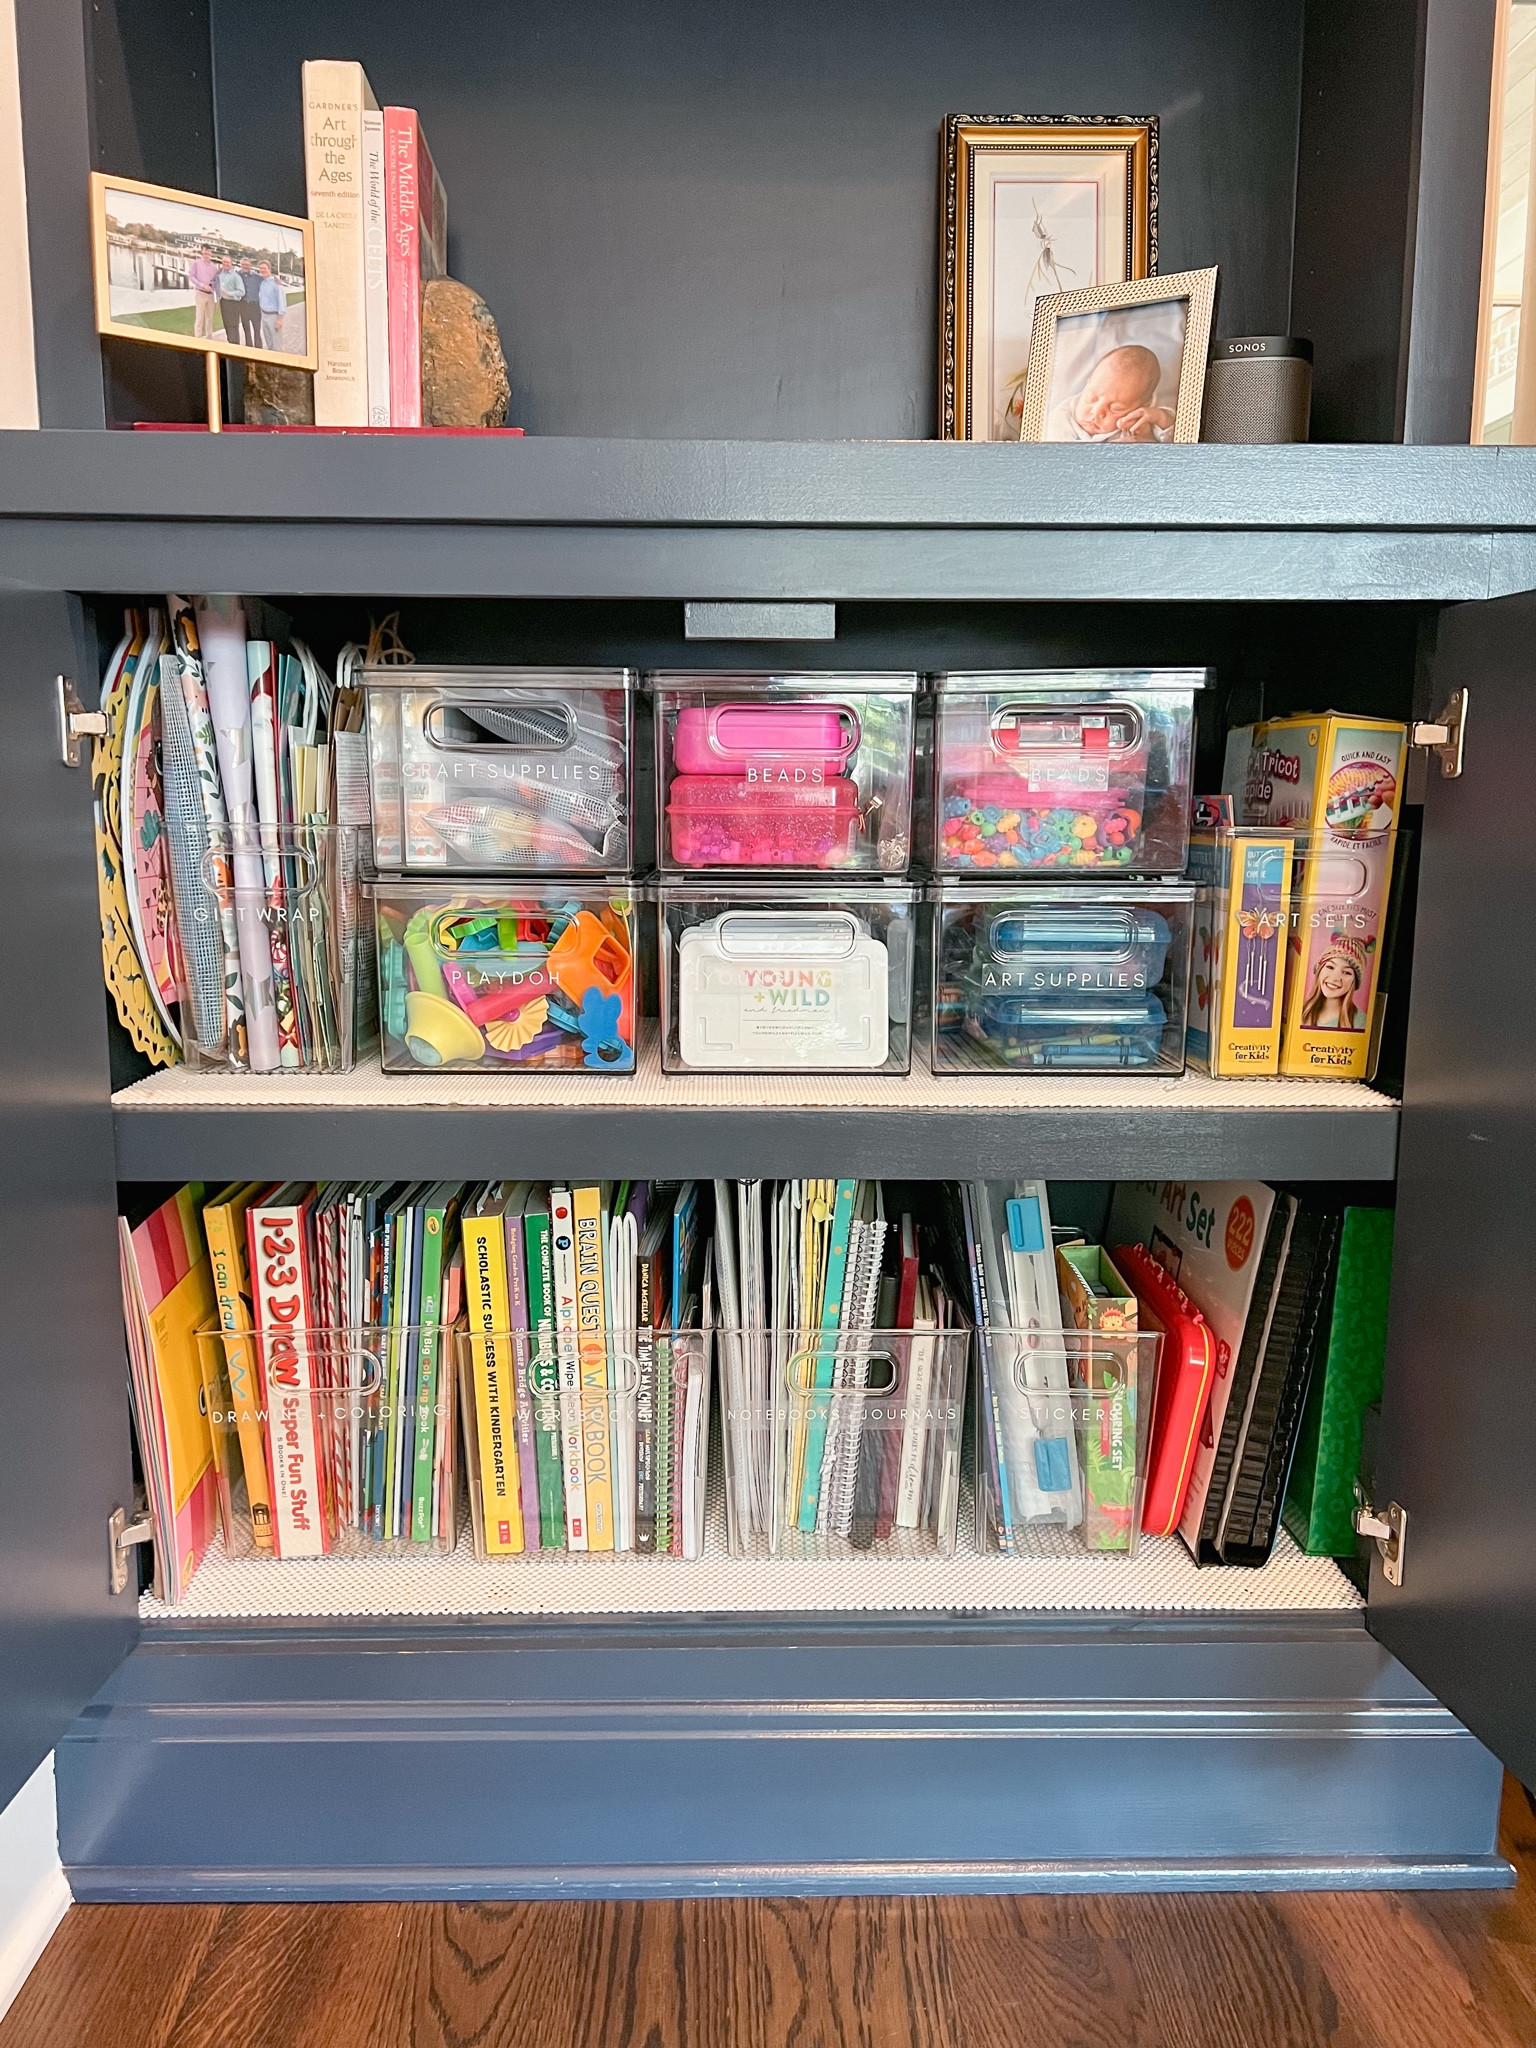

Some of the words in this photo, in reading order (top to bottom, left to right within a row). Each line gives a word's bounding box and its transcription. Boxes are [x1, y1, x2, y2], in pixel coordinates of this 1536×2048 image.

[308, 101, 359, 111] GARDNER'S
[322, 116, 346, 130] Art
[398, 126, 412, 158] The
[325, 150, 346, 164] the
[369, 152, 378, 170] The
[318, 168, 352, 184] Ages
[370, 171, 380, 198] World
[310, 190, 336, 198] seventh
[337, 190, 359, 198] edition
[399, 162, 414, 218] Middle
[368, 199, 380, 211] of
[370, 209, 380, 224] the
[396, 220, 414, 257] Ages
[366, 226, 385, 290] CELTS
[1228, 342, 1266, 354] SONOS
[1262, 751, 1300, 779] Tricot
[1341, 750, 1360, 762] QUICK
[1362, 750, 1376, 759] AND
[1375, 752, 1392, 765] EASY
[402, 763, 477, 779] CRAFT
[486, 764, 601, 780] SUPPLIES
[747, 767, 824, 783] BEADS
[1030, 768, 1107, 783] BEADS
[1352, 840, 1360, 850] ET
[193, 907, 247, 922] GIFT
[256, 907, 319, 922] WRAP
[1259, 913, 1300, 928] ART
[1310, 914, 1366, 928] SETS
[1318, 906, 1332, 916] ONE
[1360, 906, 1377, 919] MOST
[452, 970, 560, 986] PLAYDOH
[744, 970, 832, 988] YOUNG
[984, 972, 1026, 986] ART
[1034, 972, 1145, 987] SUPPLIES
[768, 988, 831, 1006] WILD
[1228, 1042, 1271, 1052] Creativity
[1235, 1052, 1248, 1060] for
[1248, 1050, 1270, 1060] Kids
[1302, 1042, 1356, 1056] Creativity
[1310, 1054, 1326, 1064] for
[1327, 1054, 1353, 1066] Kids
[1186, 1190, 1216, 1249] Set
[1228, 1206, 1253, 1246] 222
[510, 1227, 518, 1254] Bridging
[540, 1230, 548, 1244] THE
[578, 1218, 598, 1275] BRAIN
[383, 1265, 388, 1273] TO
[541, 1245, 550, 1282] COMPLETE
[216, 1262, 228, 1290] can
[476, 1236, 492, 1311] SCHOLASTIC
[542, 1283, 550, 1304] BOOK
[219, 1294, 236, 1332] draw
[543, 1306, 550, 1317] OF
[579, 1280, 602, 1339] QUEST
[268, 1294, 301, 1386] Draw
[421, 1338, 432, 1354] Big
[483, 1316, 496, 1368] SUCCESS
[516, 1327, 526, 1367] Summer
[638, 1344, 652, 1372] TIMES
[420, 1358, 431, 1402] Coloring
[540, 1367, 552, 1376] &
[487, 1370, 499, 1404] WITH
[518, 1369, 527, 1398] Bridge
[280, 1397, 300, 1449] Super
[317, 1412, 326, 1420] +
[419, 1405, 430, 1433] Book
[520, 1400, 531, 1444] Activities
[727, 1409, 840, 1421] NOTEBOOKS
[862, 1408, 957, 1420] JOURNALS
[1020, 1408, 1117, 1421] STICKERS
[1112, 1385, 1124, 1448] LOURING
[582, 1369, 607, 1485] WORKBOOK
[490, 1406, 506, 1497] KINDERGARTEN
[567, 1425, 582, 1492] Workbook
[1112, 1448, 1122, 1471] SET
[287, 1453, 304, 1486] Fun
[290, 1489, 311, 1532] Stuff
